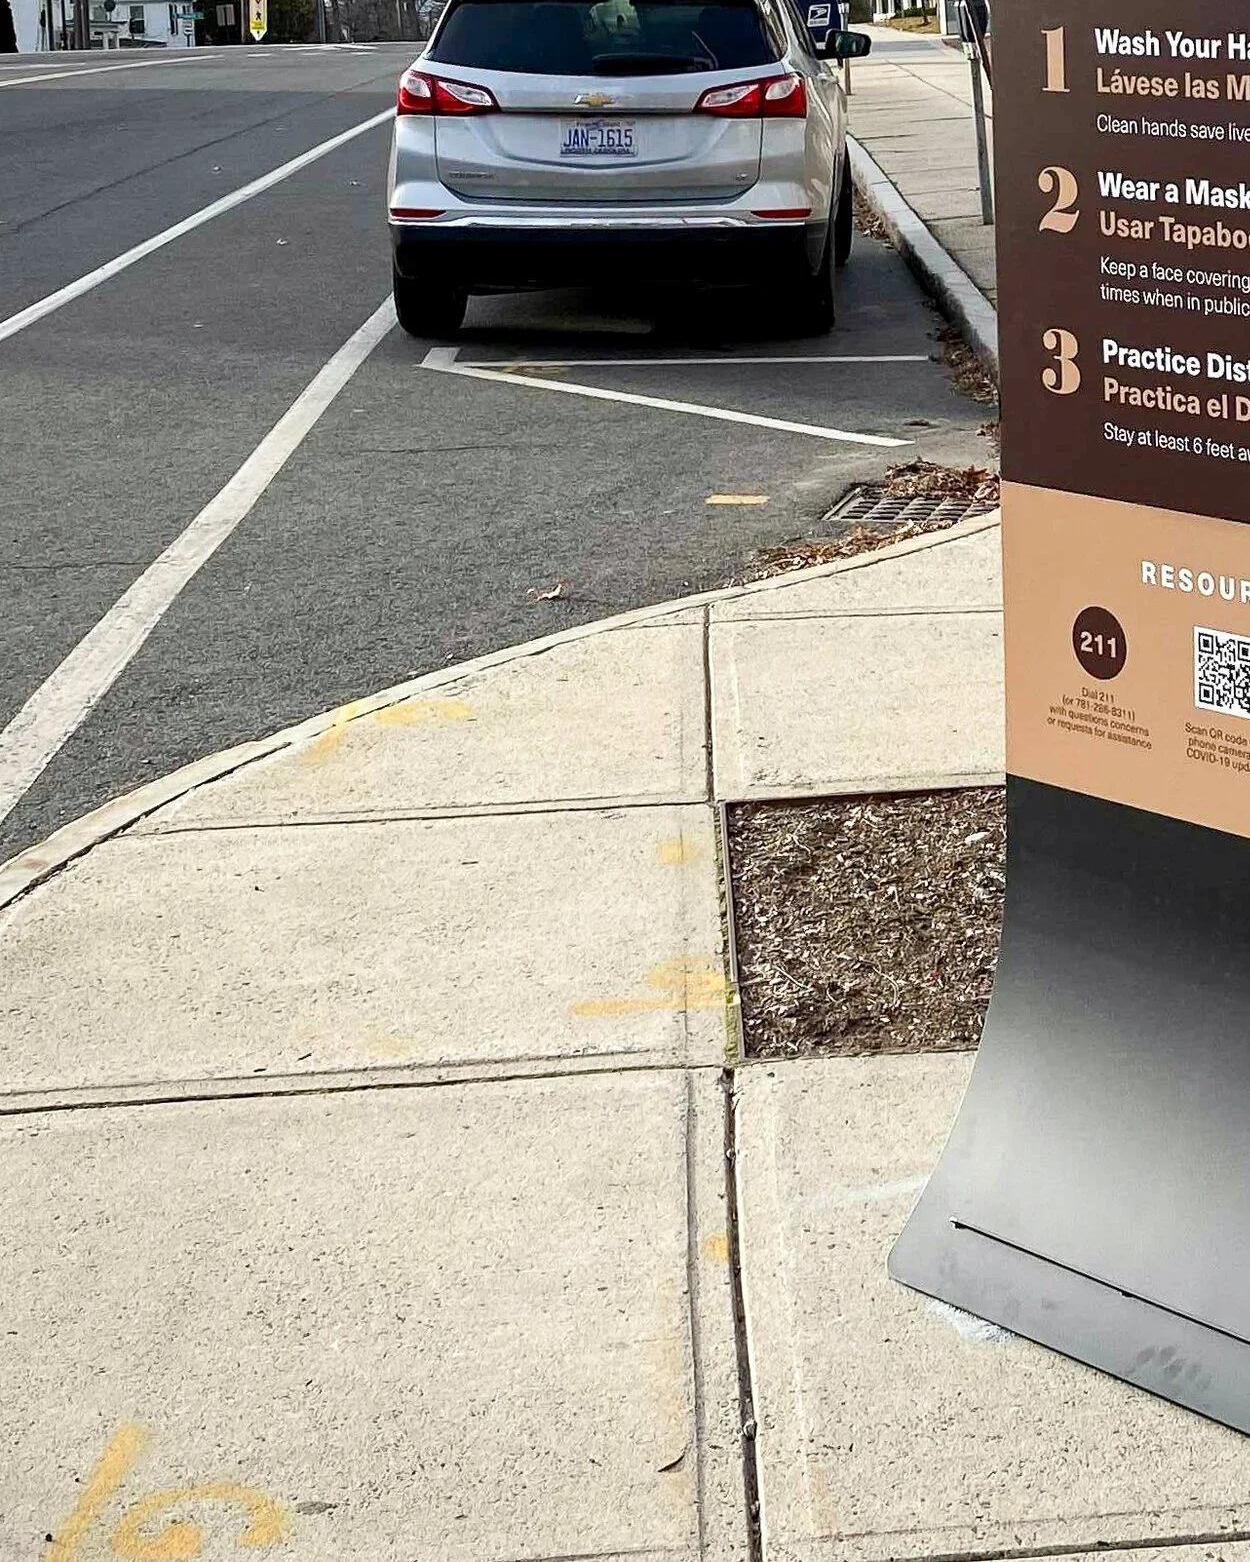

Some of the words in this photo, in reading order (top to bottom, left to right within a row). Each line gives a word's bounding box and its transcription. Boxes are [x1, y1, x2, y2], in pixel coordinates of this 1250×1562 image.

[1094, 27, 1160, 56] Wash
[1166, 30, 1223, 58] Your
[1041, 26, 1071, 93] 1
[1096, 67, 1179, 97] Lávese
[1184, 72, 1220, 100] las
[563, 128, 633, 148] JAN-1615
[1096, 114, 1138, 135] Clean
[1142, 117, 1188, 139] hands
[1190, 125, 1225, 141] save
[1037, 166, 1080, 234] 2
[1097, 171, 1160, 202] Wear
[1164, 183, 1180, 204] a
[1100, 210, 1155, 240] Usar
[1100, 256, 1136, 279] Keep
[1139, 264, 1149, 279] a
[1151, 262, 1183, 283] face
[1186, 269, 1250, 294] covering
[1101, 283, 1140, 304] times
[1143, 289, 1184, 311] when
[1187, 292, 1201, 311] in
[1204, 296, 1250, 318] public
[1042, 328, 1082, 395] 3
[1102, 338, 1201, 376] Practice
[1103, 376, 1201, 415] Practica
[1206, 394, 1229, 419] el
[1103, 421, 1136, 447] Stay
[1137, 431, 1153, 447] at
[1155, 429, 1191, 453] least
[1192, 437, 1203, 455] 6
[1205, 438, 1235, 460] feet
[1080, 630, 1117, 659] 211
[1099, 691, 1114, 704] 211
[1047, 717, 1056, 725] or
[1057, 719, 1093, 736] requests
[1094, 726, 1106, 738] for
[1107, 731, 1152, 750] assistance
[1184, 721, 1208, 736] Scan
[1209, 727, 1223, 741] QR
[1224, 733, 1248, 746] code
[1188, 737, 1217, 752] phone
[1186, 747, 1231, 768] COVID-19
